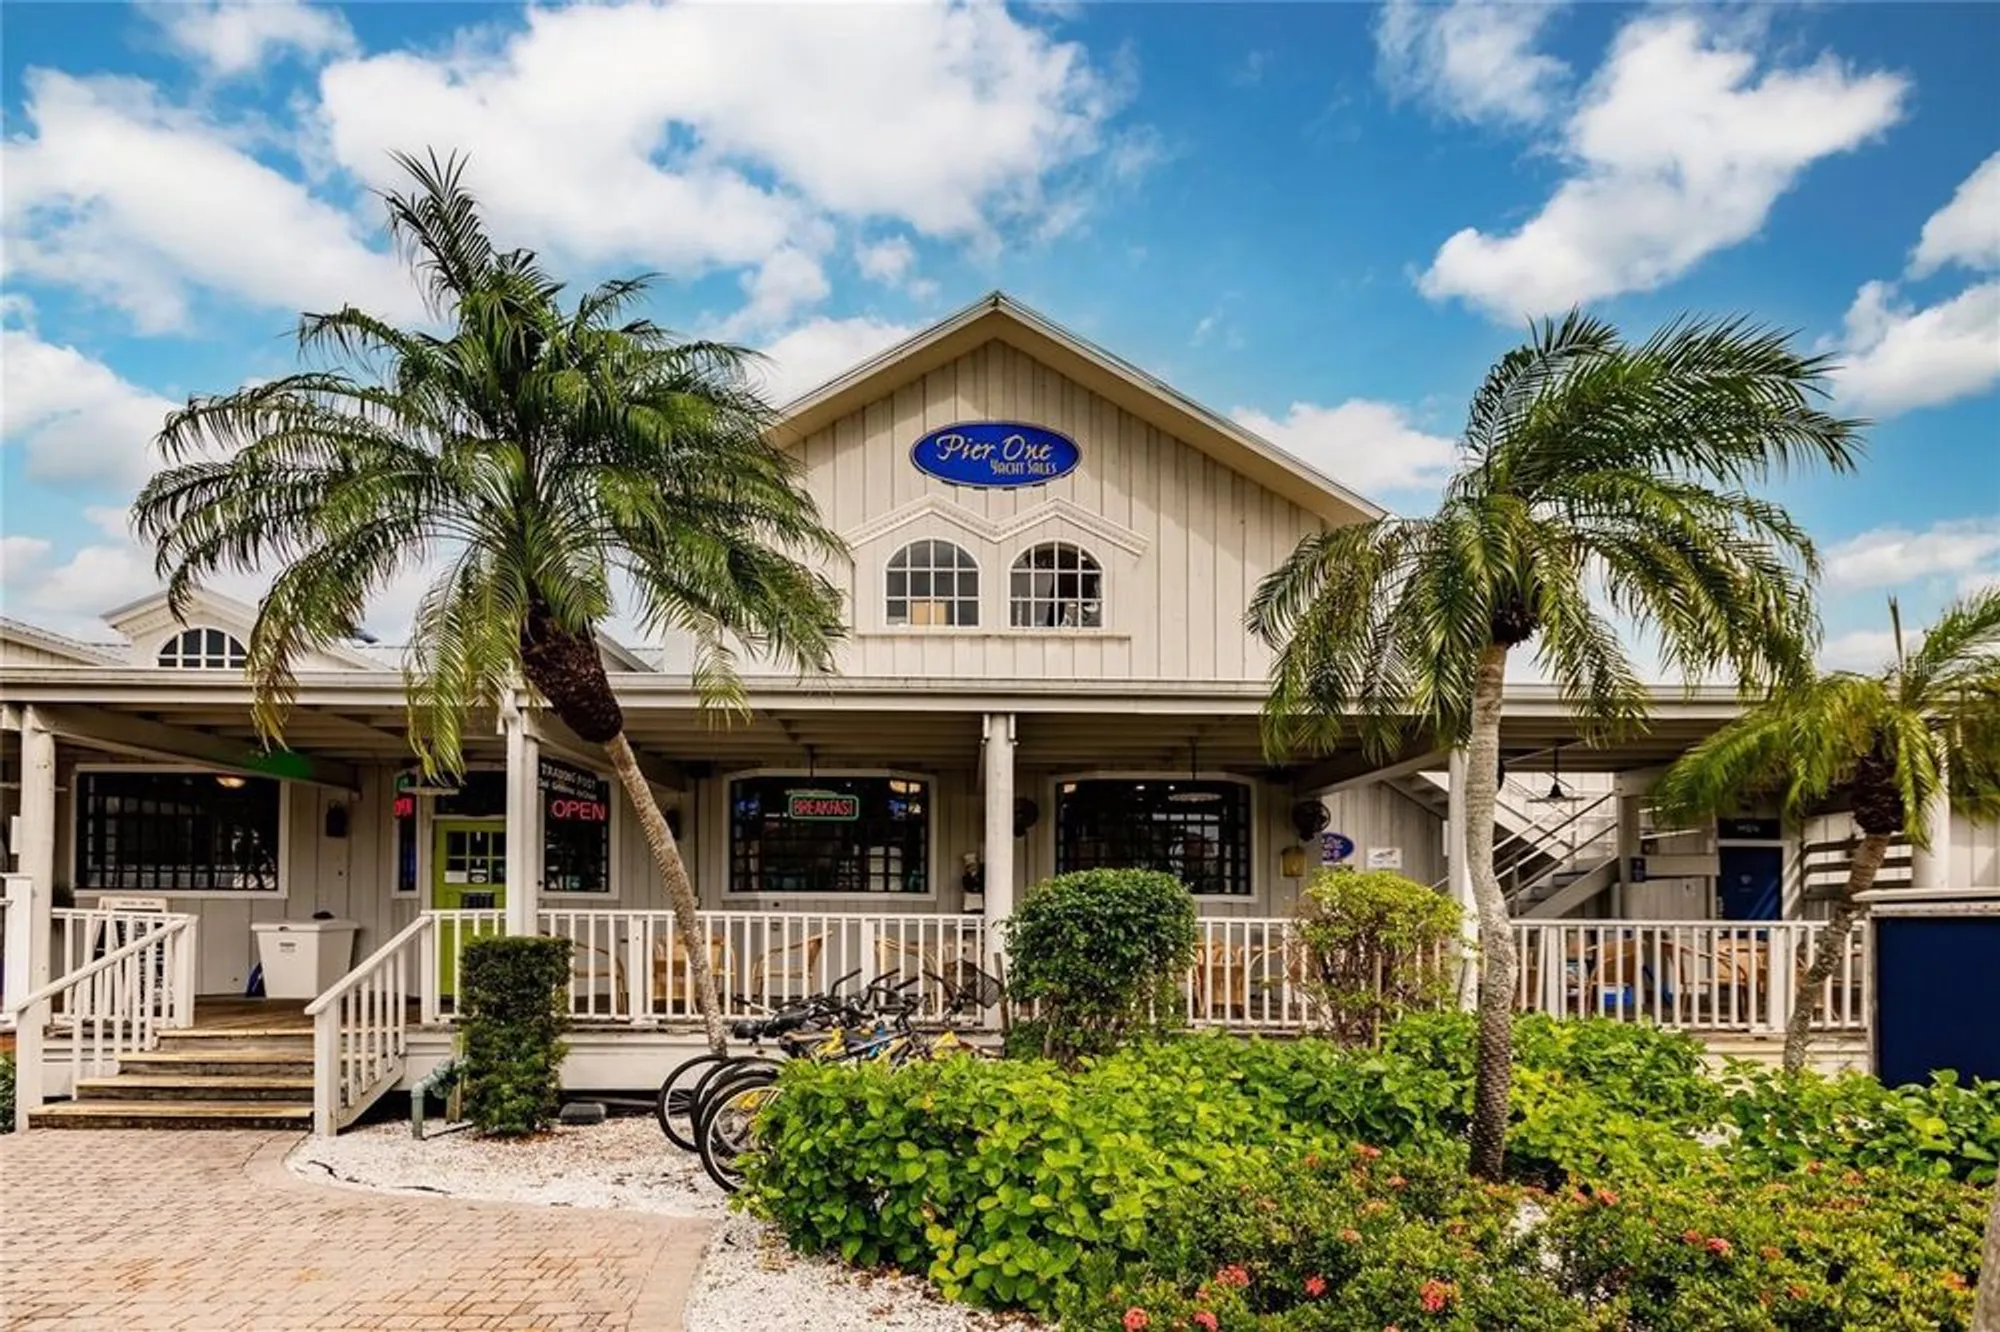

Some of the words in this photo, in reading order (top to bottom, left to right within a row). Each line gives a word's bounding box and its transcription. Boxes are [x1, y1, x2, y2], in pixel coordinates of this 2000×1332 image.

[936, 434, 996, 461] Pier
[1002, 434, 1053, 461] One
[551, 799, 606, 821] OPEN
[793, 799, 854, 816] BREAKFAST
